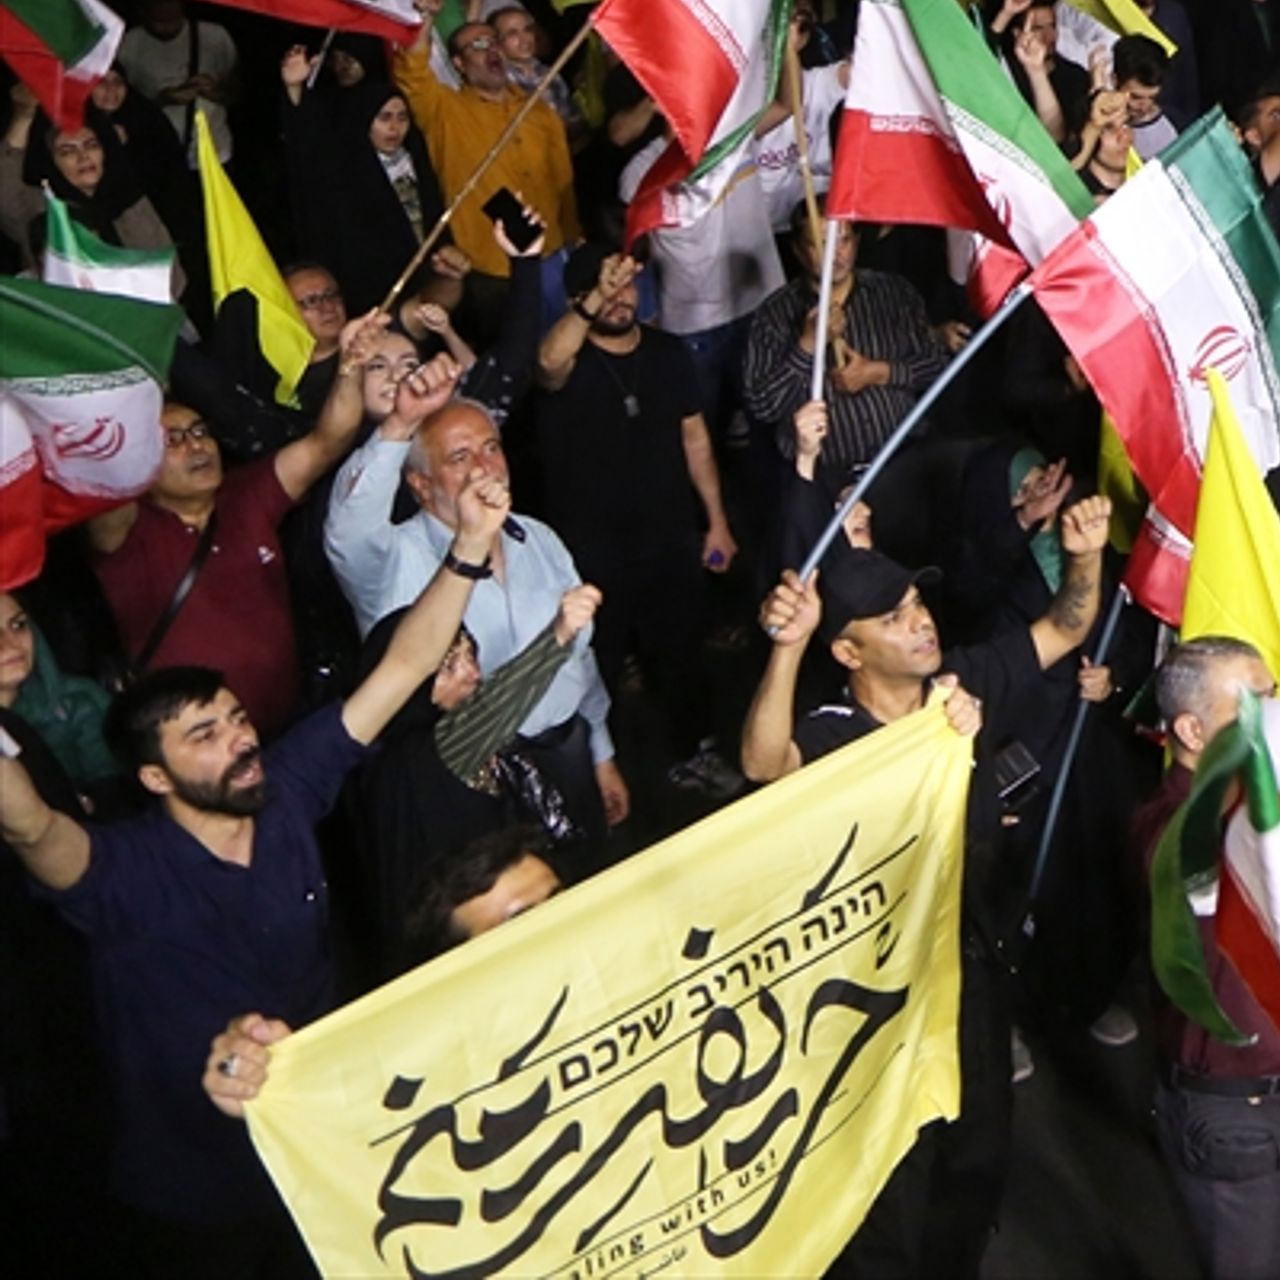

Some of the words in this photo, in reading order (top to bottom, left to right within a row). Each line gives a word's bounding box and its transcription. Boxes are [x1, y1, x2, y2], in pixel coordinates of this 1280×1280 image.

[802, 880, 889, 952] הינה
[687, 935, 790, 1021] היריב
[558, 1001, 674, 1091] שלכם
[660, 1188, 724, 1235] with
[737, 1148, 777, 1188] us!
